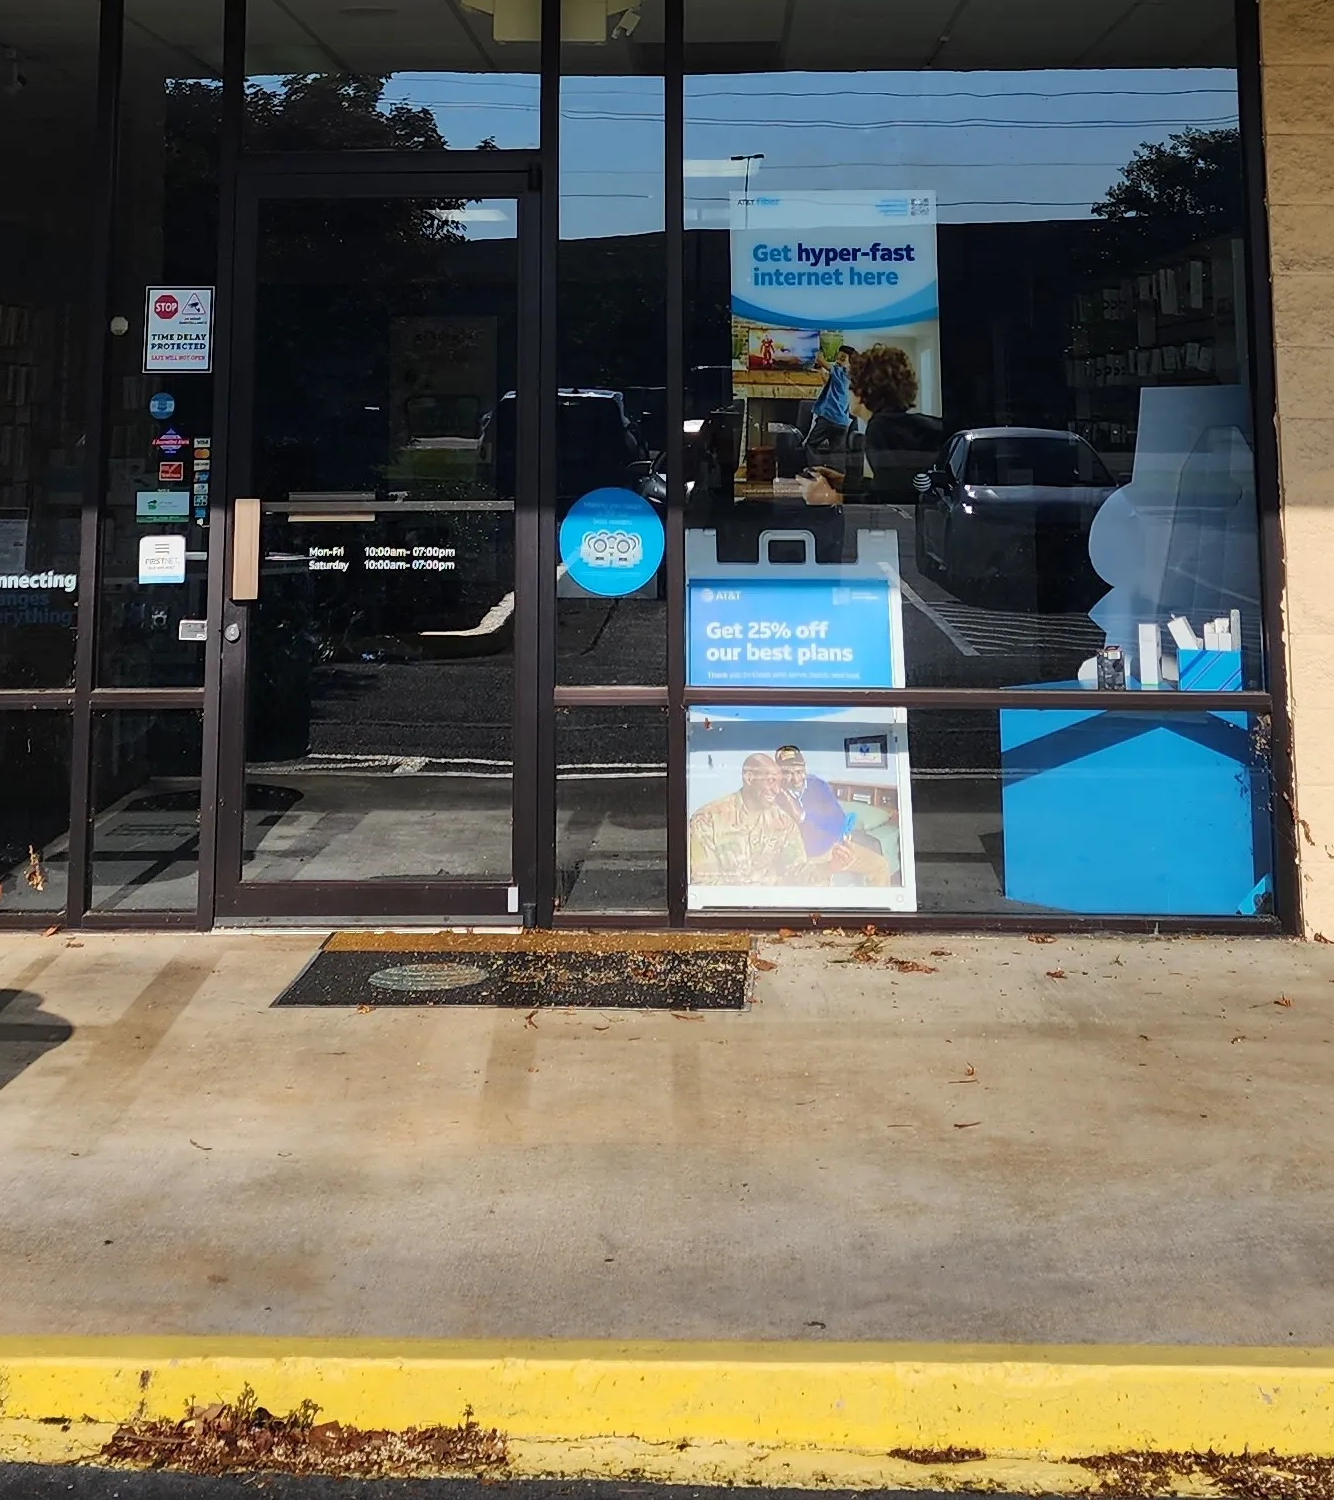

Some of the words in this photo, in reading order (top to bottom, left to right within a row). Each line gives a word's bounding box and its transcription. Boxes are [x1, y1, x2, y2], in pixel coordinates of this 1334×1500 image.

[753, 244, 791, 262] Get
[797, 242, 916, 267] hyper-fast
[753, 267, 844, 286] internet
[849, 267, 899, 286] here
[155, 302, 178, 312] STOP
[151, 333, 174, 341] TIME
[177, 333, 207, 341] DELAY
[150, 342, 207, 350] PROTECTED
[308, 547, 345, 557] Mon-Fri
[412, 547, 456, 559] 07:00pm
[308, 560, 350, 572] Saturday
[411, 560, 455, 571] 07:00pm
[715, 590, 742, 601] AT&T
[706, 621, 743, 639] Get
[747, 621, 791, 639] 25%
[795, 621, 830, 639] off
[706, 646, 742, 661] our
[746, 642, 792, 661] best
[797, 643, 854, 666] plans
